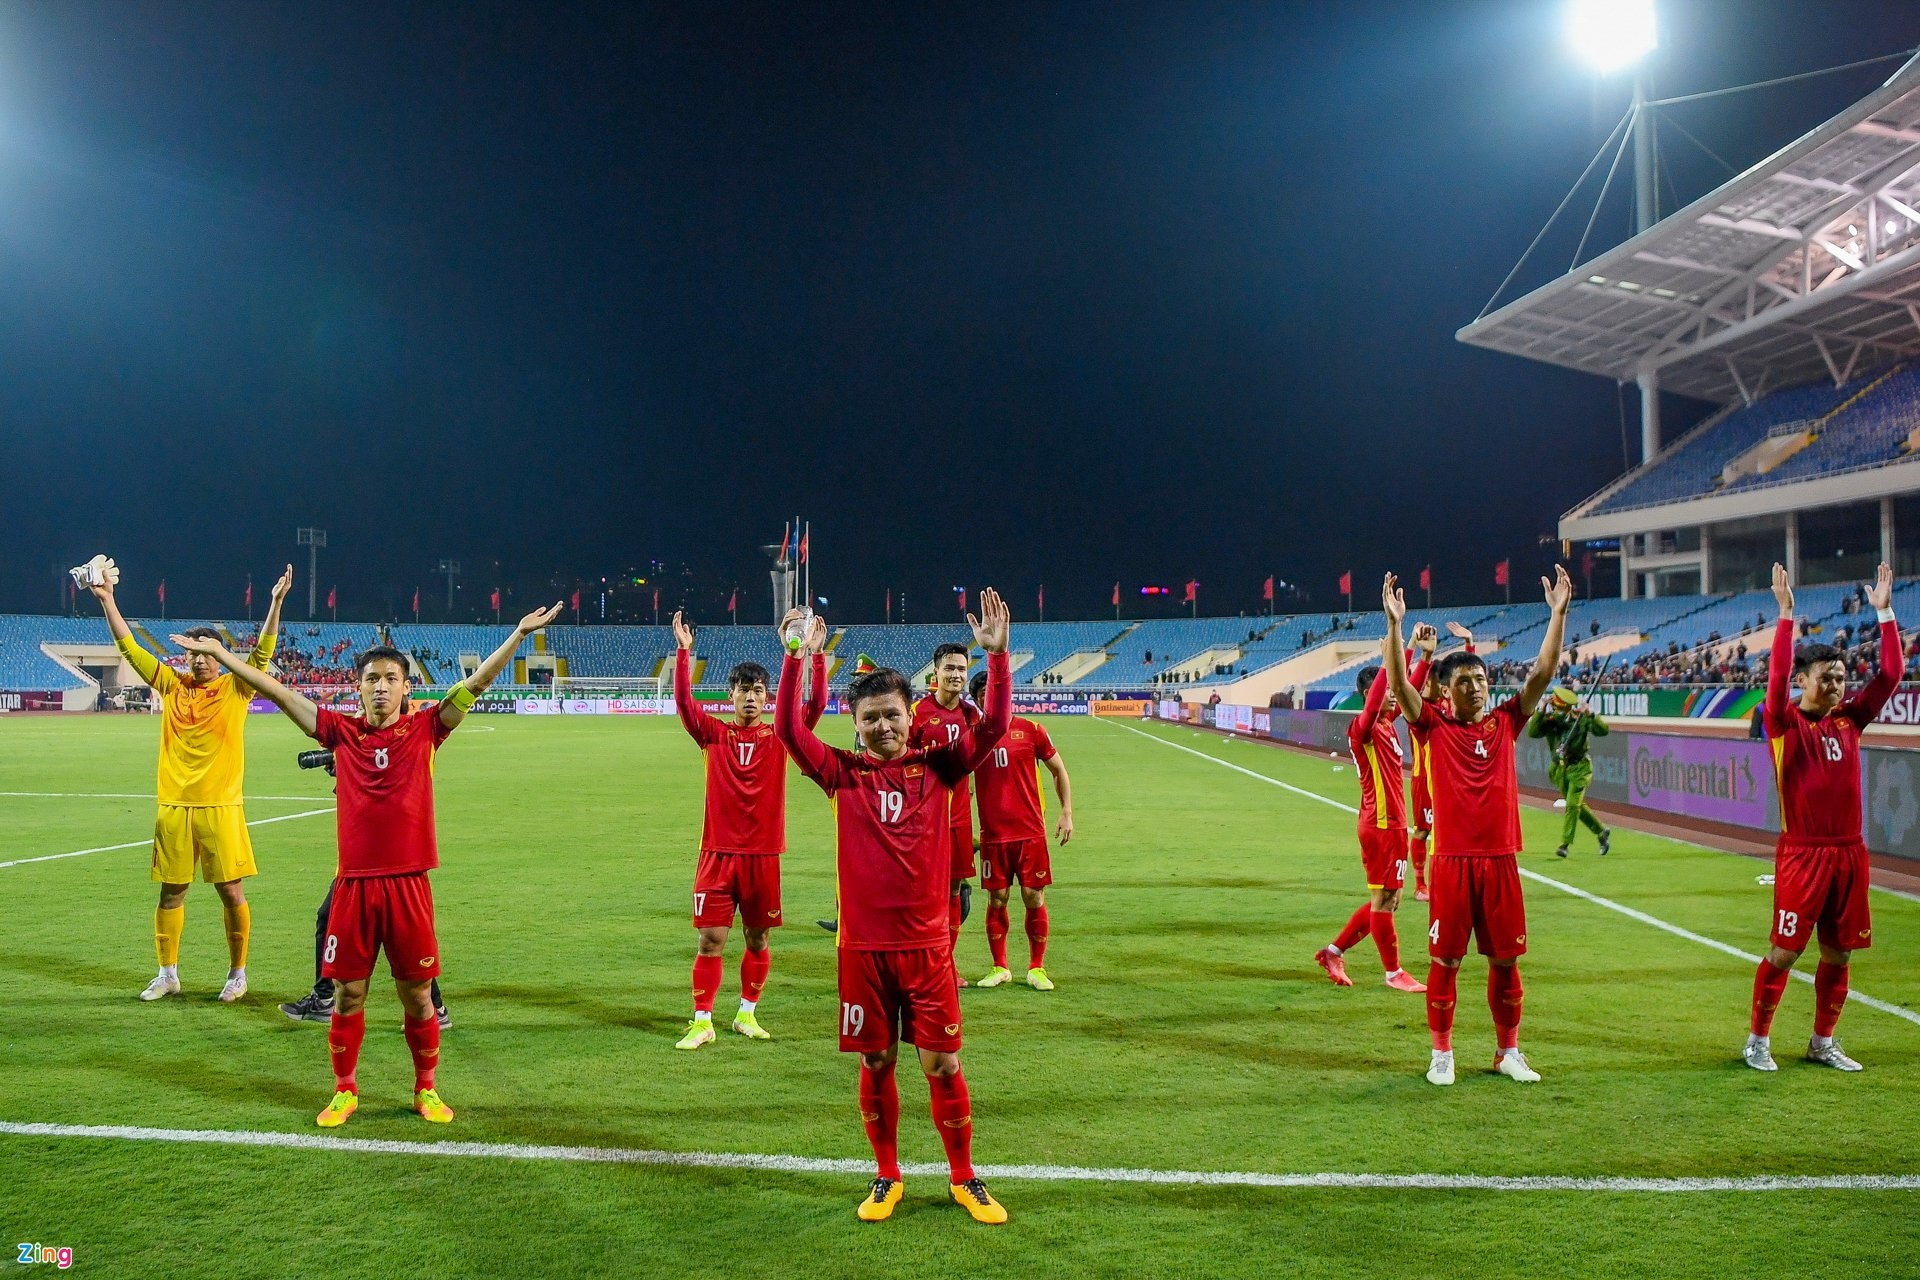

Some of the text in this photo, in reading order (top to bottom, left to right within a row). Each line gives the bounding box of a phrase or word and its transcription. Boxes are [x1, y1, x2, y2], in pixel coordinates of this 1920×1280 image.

[0, 694, 21, 709] TAR
[607, 700, 665, 709] HD SAISON
[1011, 703, 1088, 713] he-AFC.com
[1093, 703, 1135, 713] Continental
[1879, 693, 1920, 722] ASI
[737, 742, 755, 766] 17
[993, 747, 1009, 768] 10
[1474, 739, 1488, 759] 4
[1821, 736, 1842, 761] 13
[1634, 746, 1737, 800] Continental
[877, 790, 903, 823] 19
[693, 892, 706, 916] 17
[1428, 918, 1440, 945] 4
[1778, 909, 1798, 937] 13
[324, 934, 338, 963] 8
[842, 1001, 865, 1037] 19
